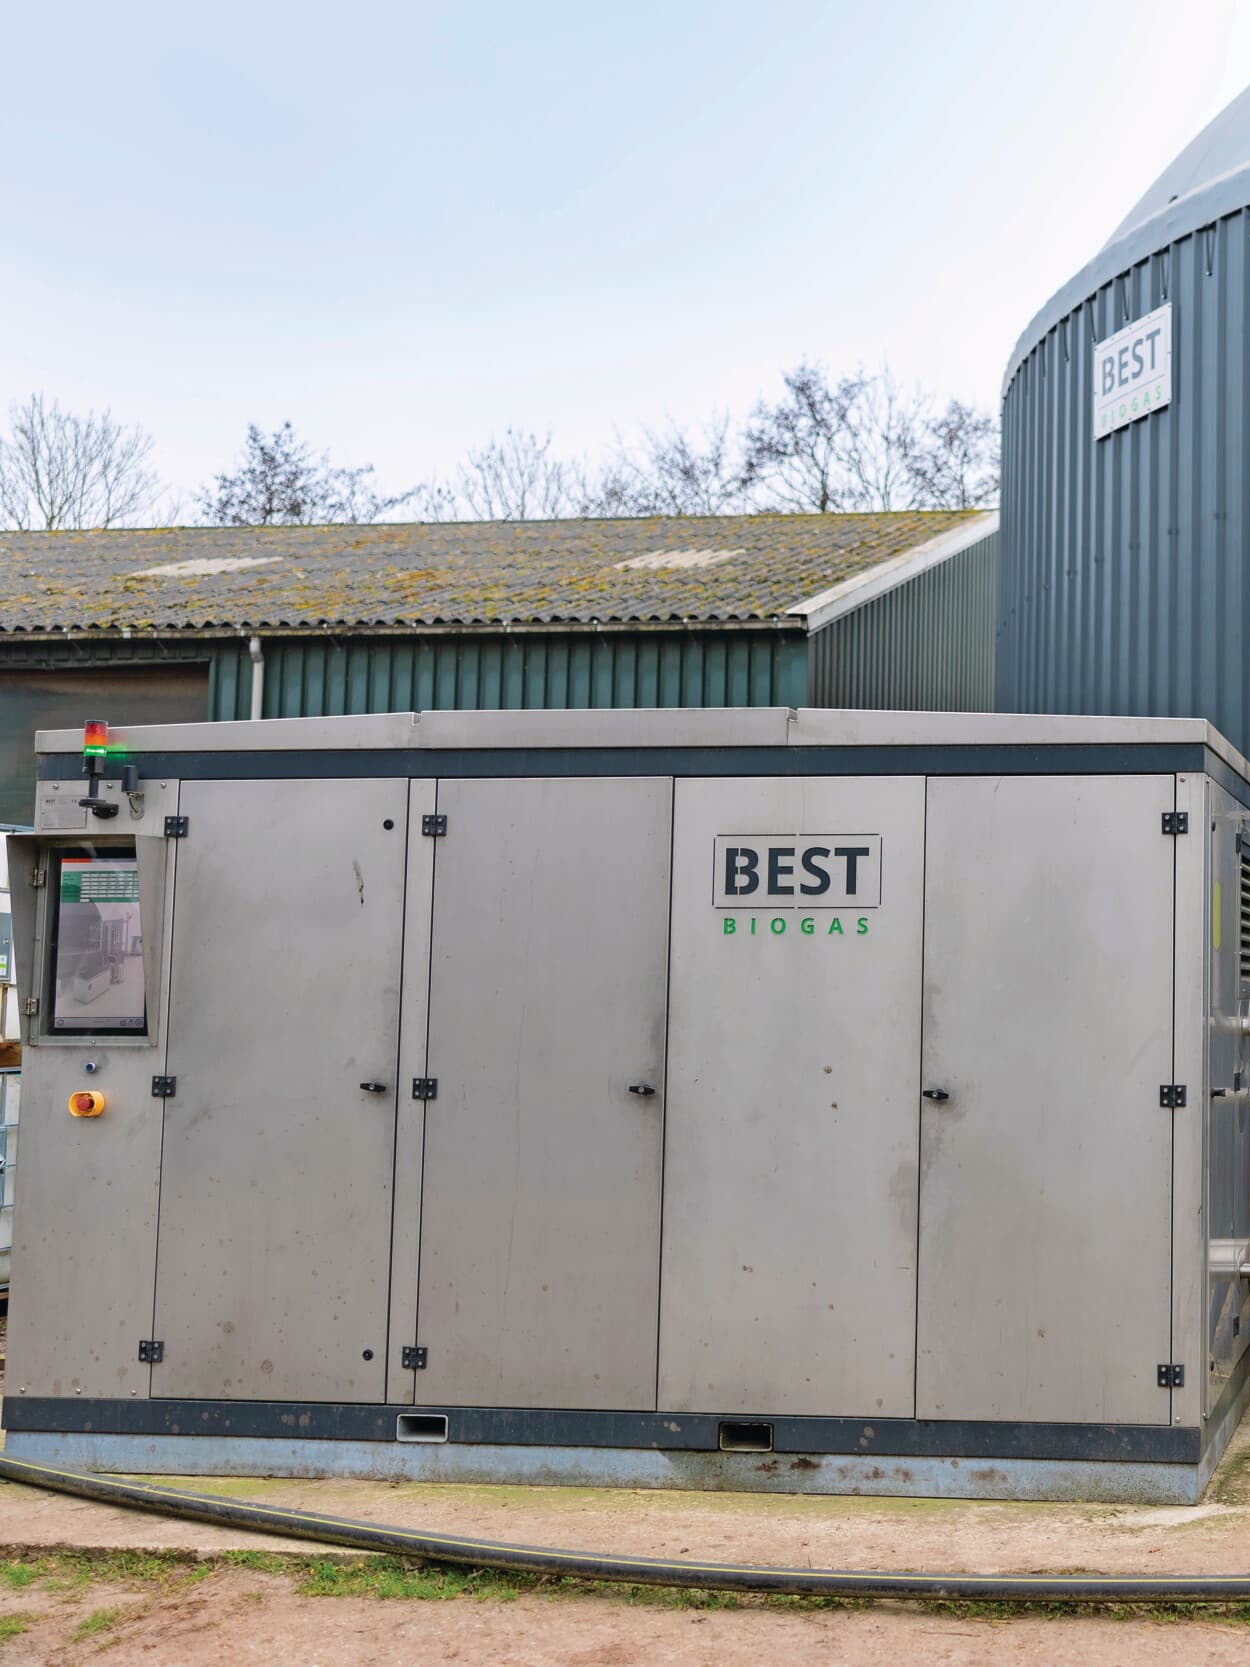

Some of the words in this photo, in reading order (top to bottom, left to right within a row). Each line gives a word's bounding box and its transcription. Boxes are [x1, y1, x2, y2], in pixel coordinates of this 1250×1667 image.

[1102, 328, 1161, 396] BEST
[725, 847, 869, 895] BEST
[723, 917, 869, 936] BIOGAS
